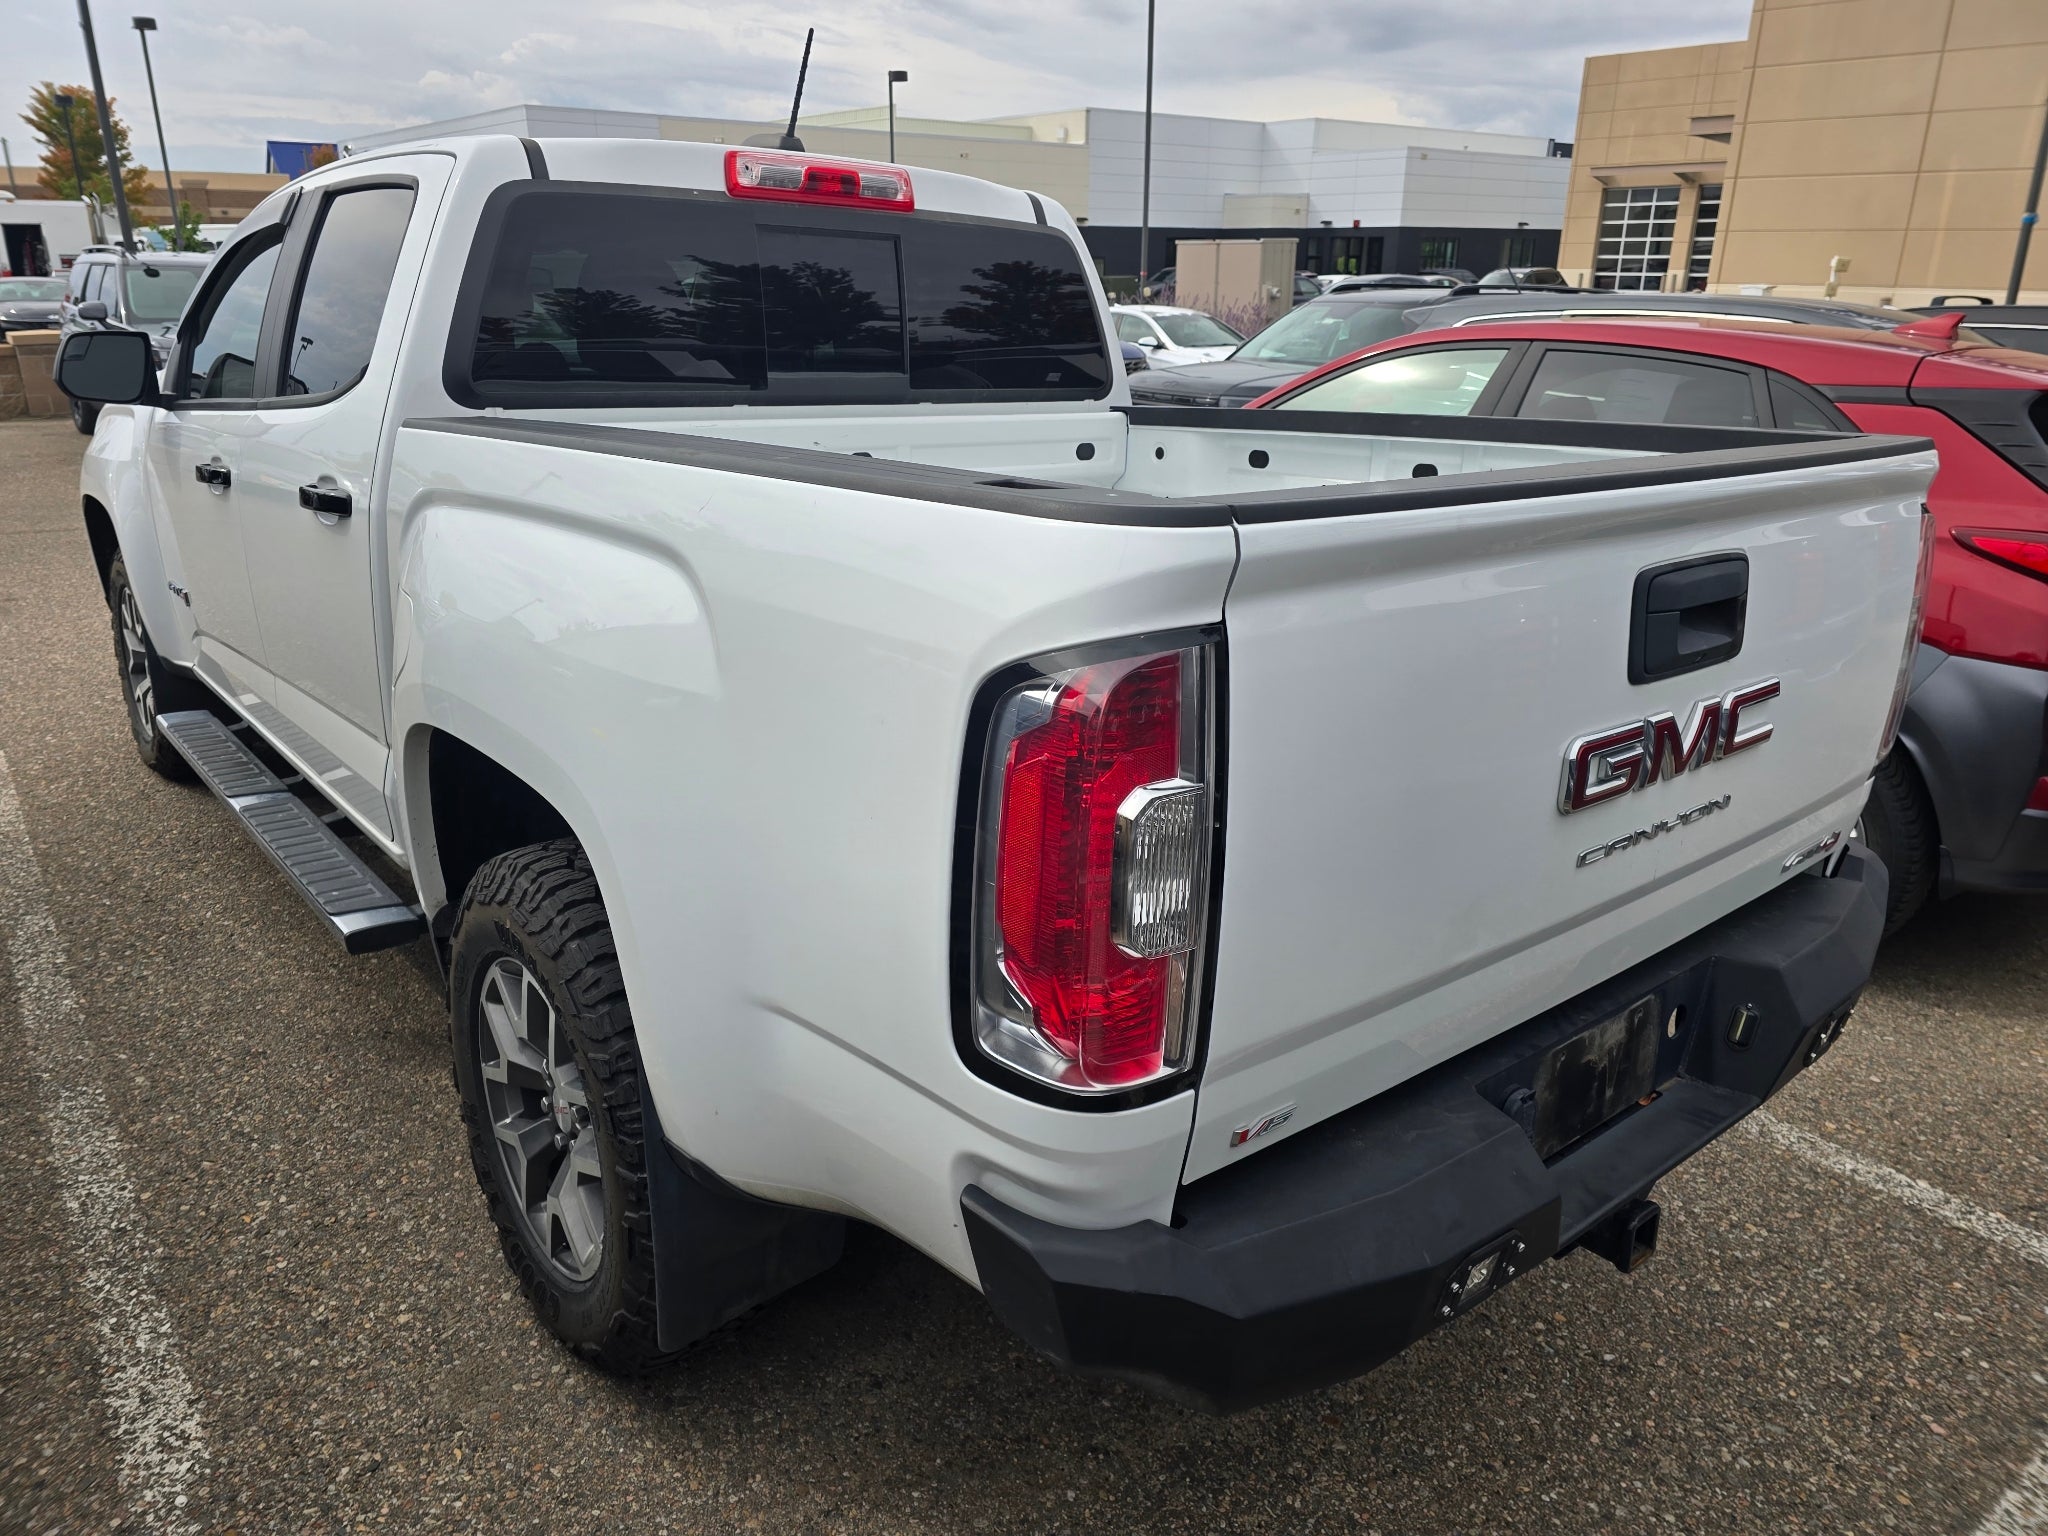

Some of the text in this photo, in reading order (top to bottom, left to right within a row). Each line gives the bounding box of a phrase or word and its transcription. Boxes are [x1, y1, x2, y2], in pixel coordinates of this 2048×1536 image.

[1557, 677, 1780, 816] GMC
[1576, 794, 1731, 868] CANYON
[1230, 1104, 1297, 1148] V6
